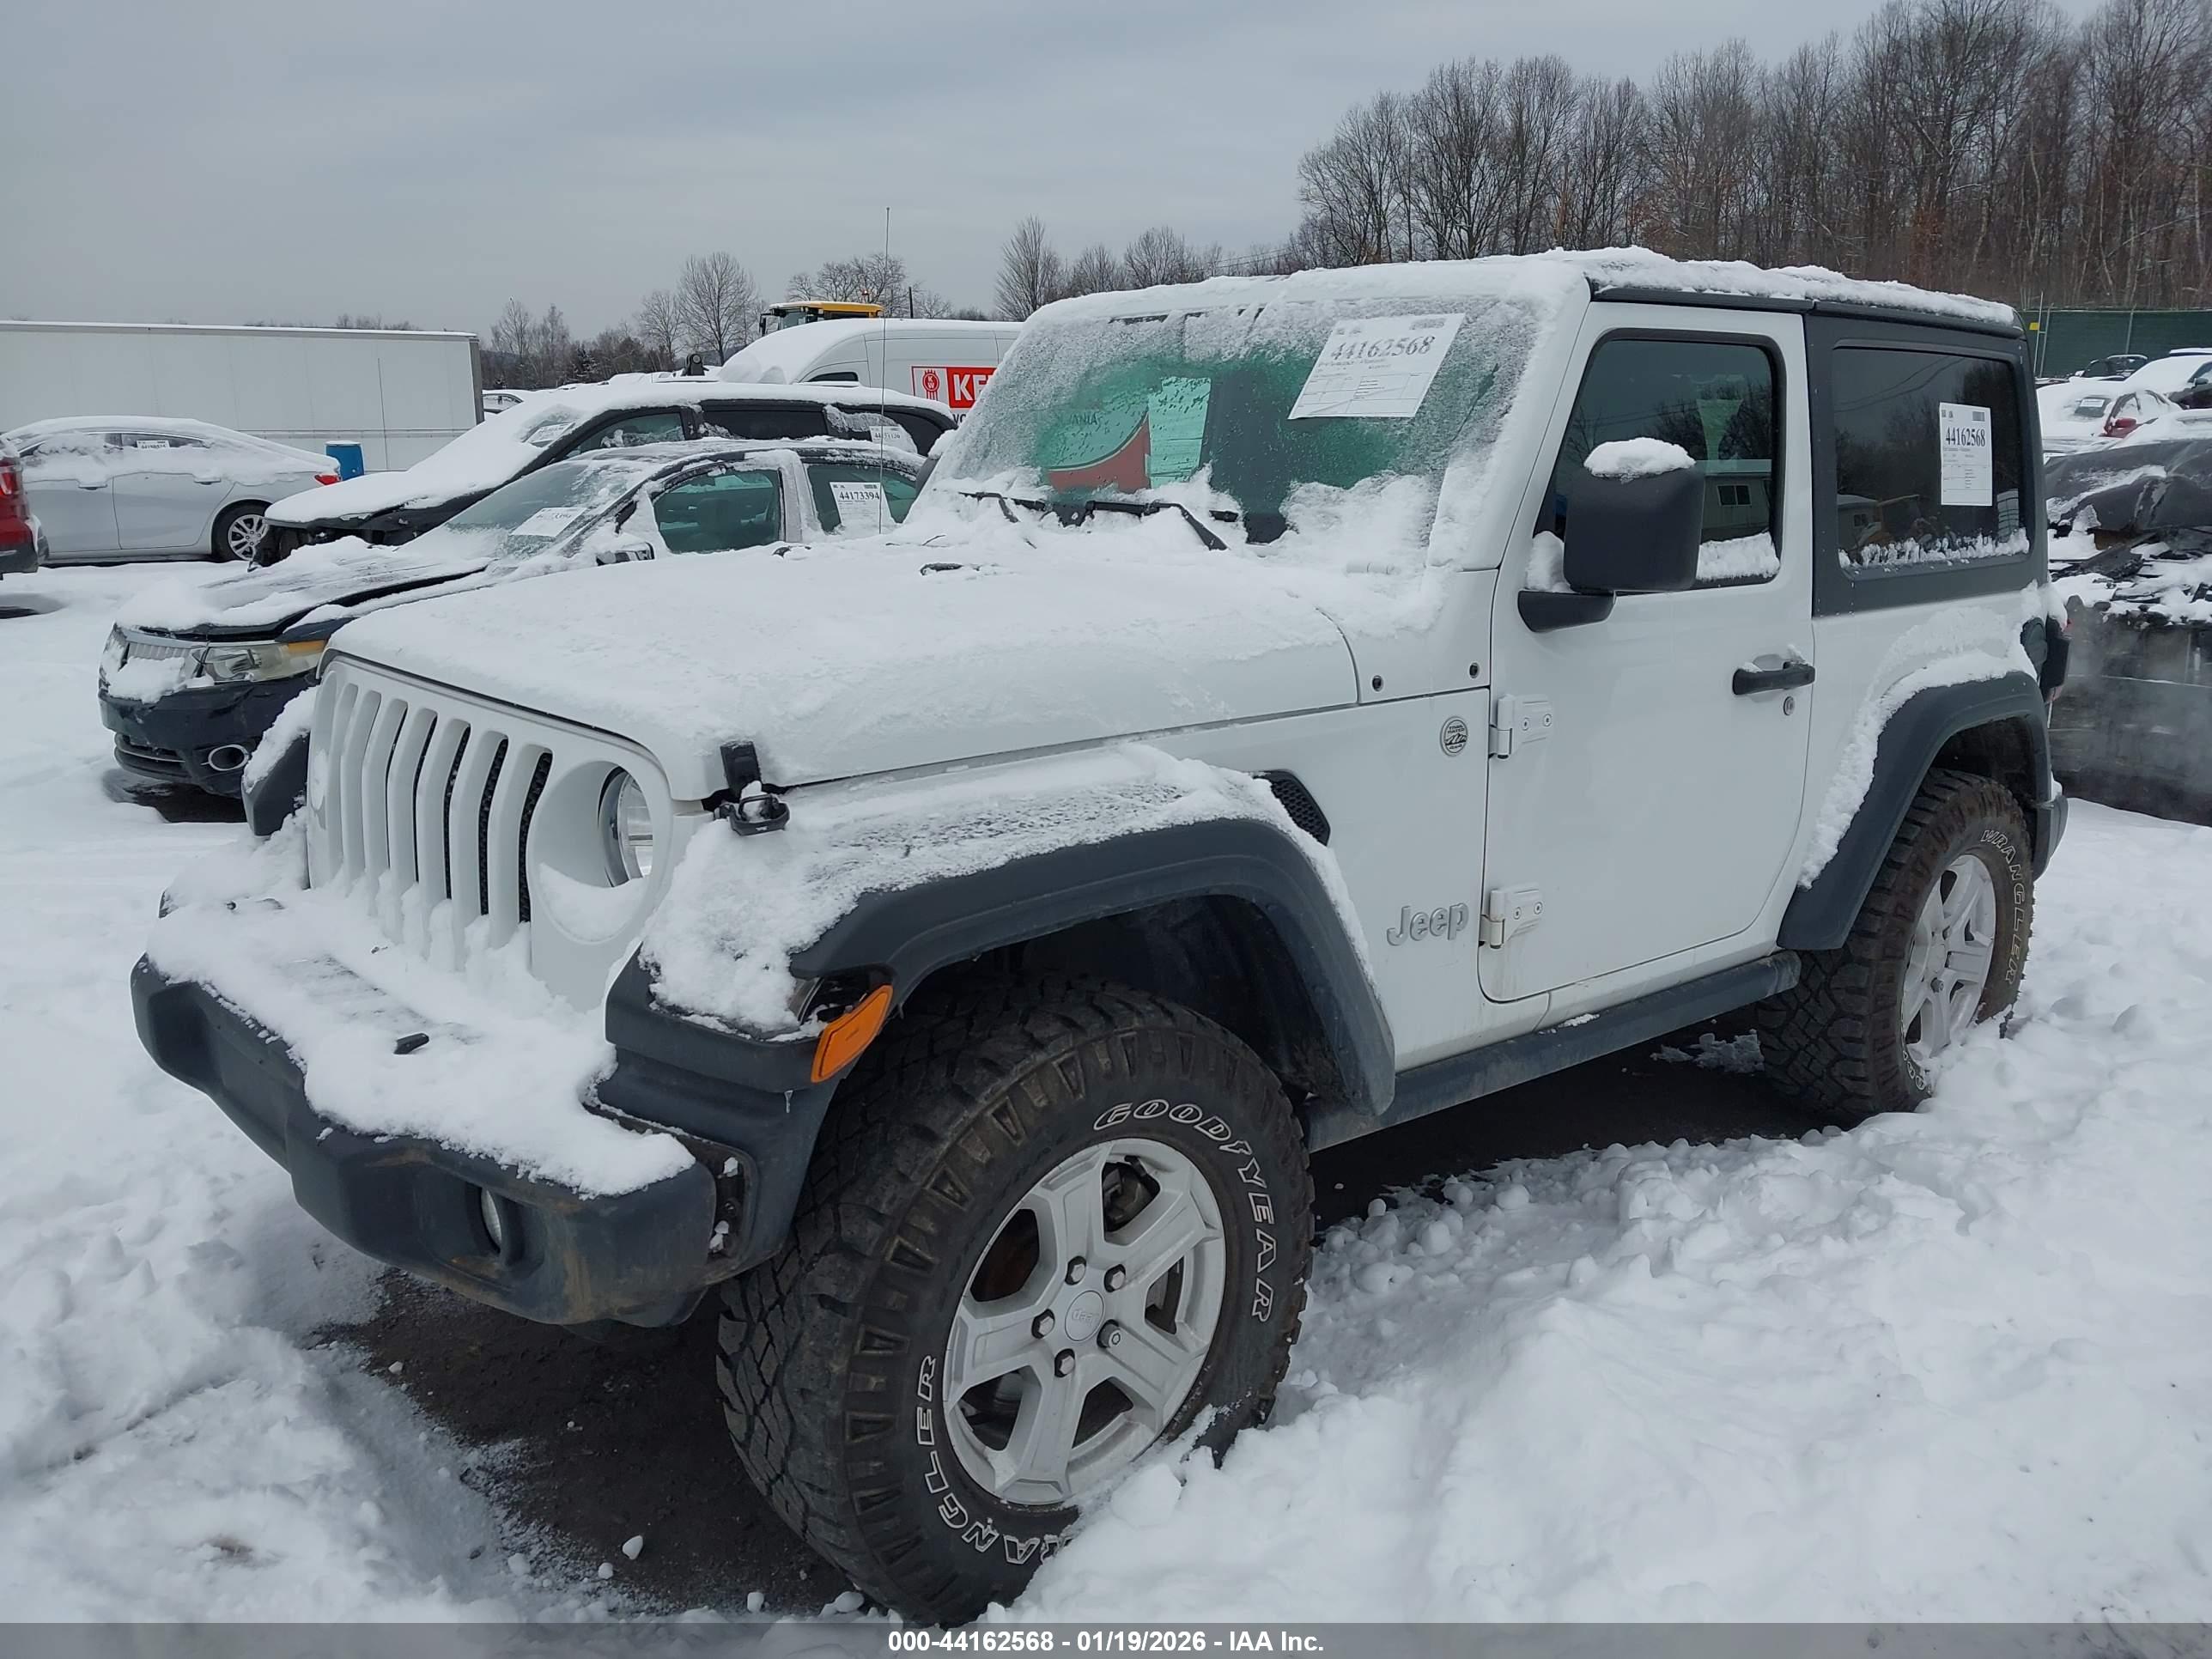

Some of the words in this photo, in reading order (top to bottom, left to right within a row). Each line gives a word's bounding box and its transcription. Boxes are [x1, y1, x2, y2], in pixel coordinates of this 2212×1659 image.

[1330, 336, 1436, 361] 44162568
[1945, 427, 1986, 447] 44162568
[839, 491, 879, 501] 44173394
[1386, 902, 1469, 946] Jeep
[1981, 830, 2026, 985] WRANGLER
[1093, 1098, 1277, 1323] GOODYEAR
